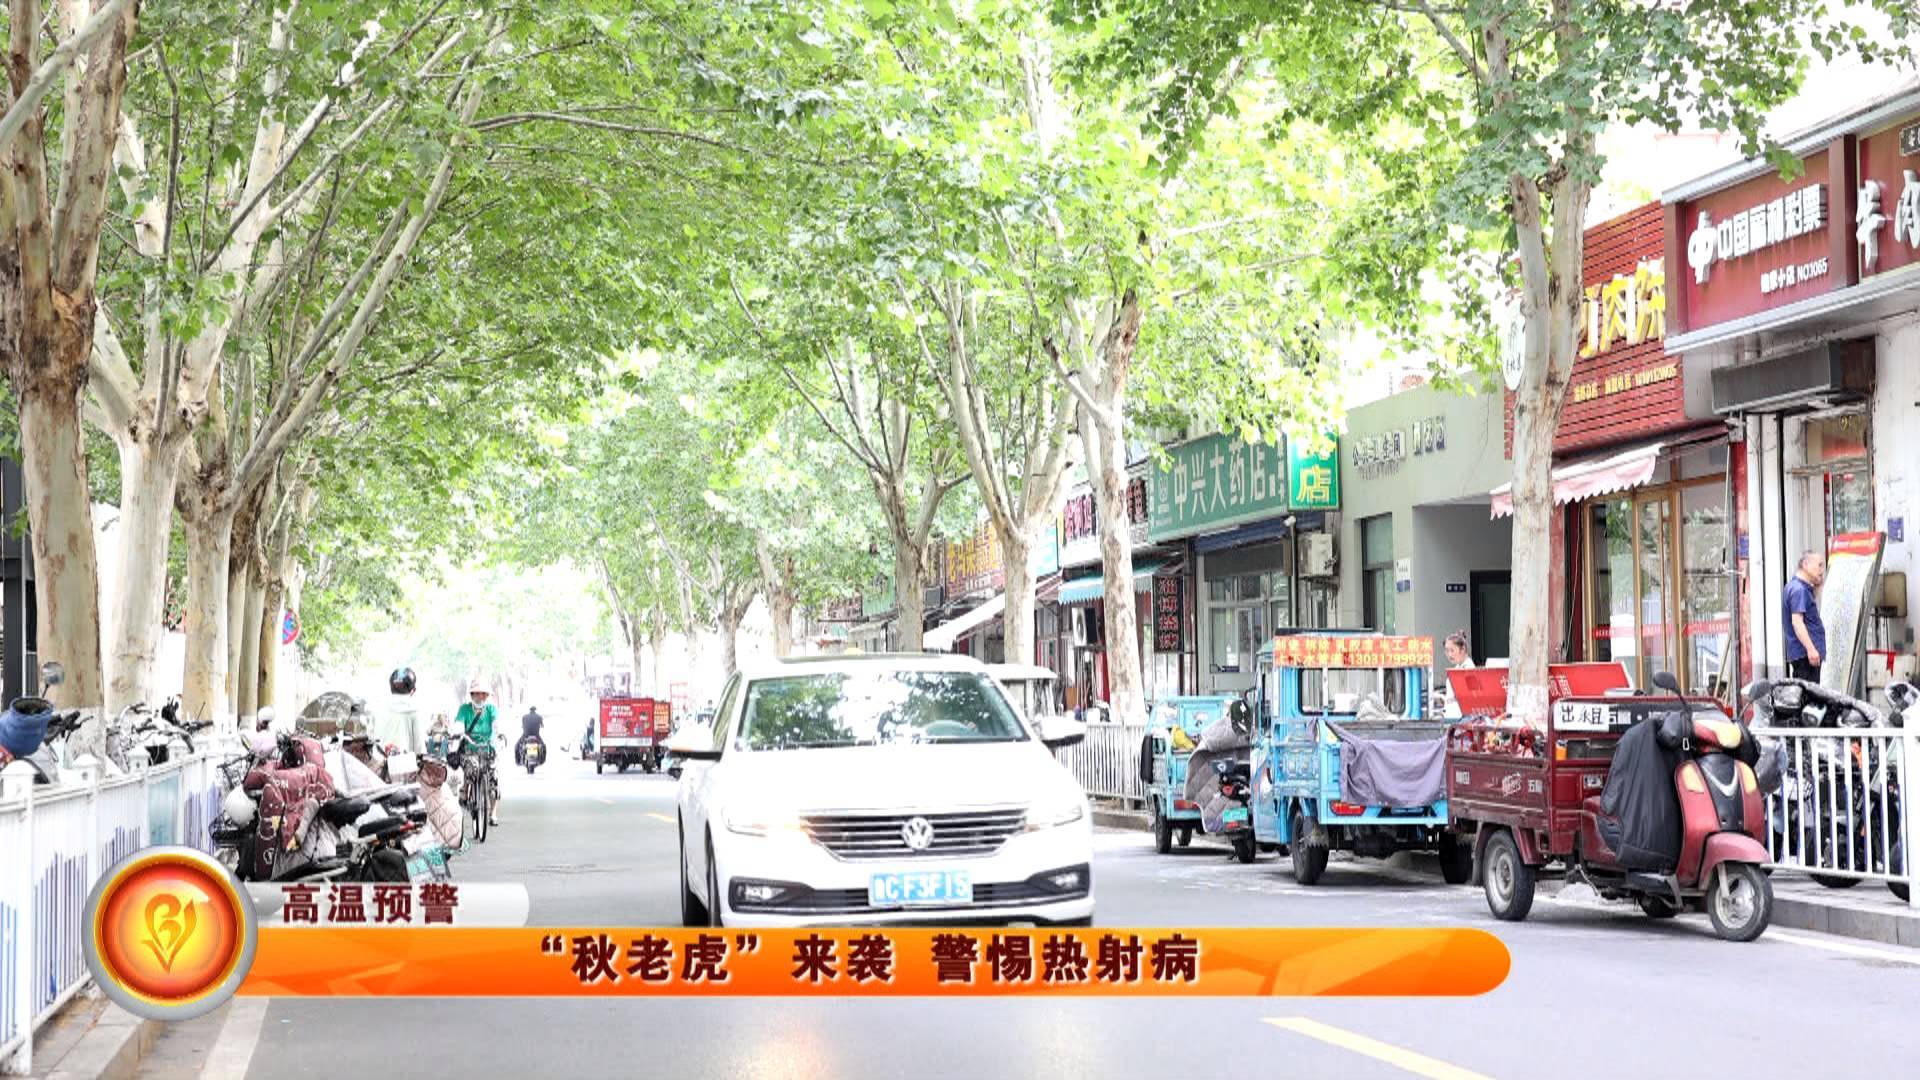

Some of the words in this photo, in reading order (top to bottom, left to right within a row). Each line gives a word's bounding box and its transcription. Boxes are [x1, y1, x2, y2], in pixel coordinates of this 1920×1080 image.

[1174, 437, 1266, 521] 中兴大药店
